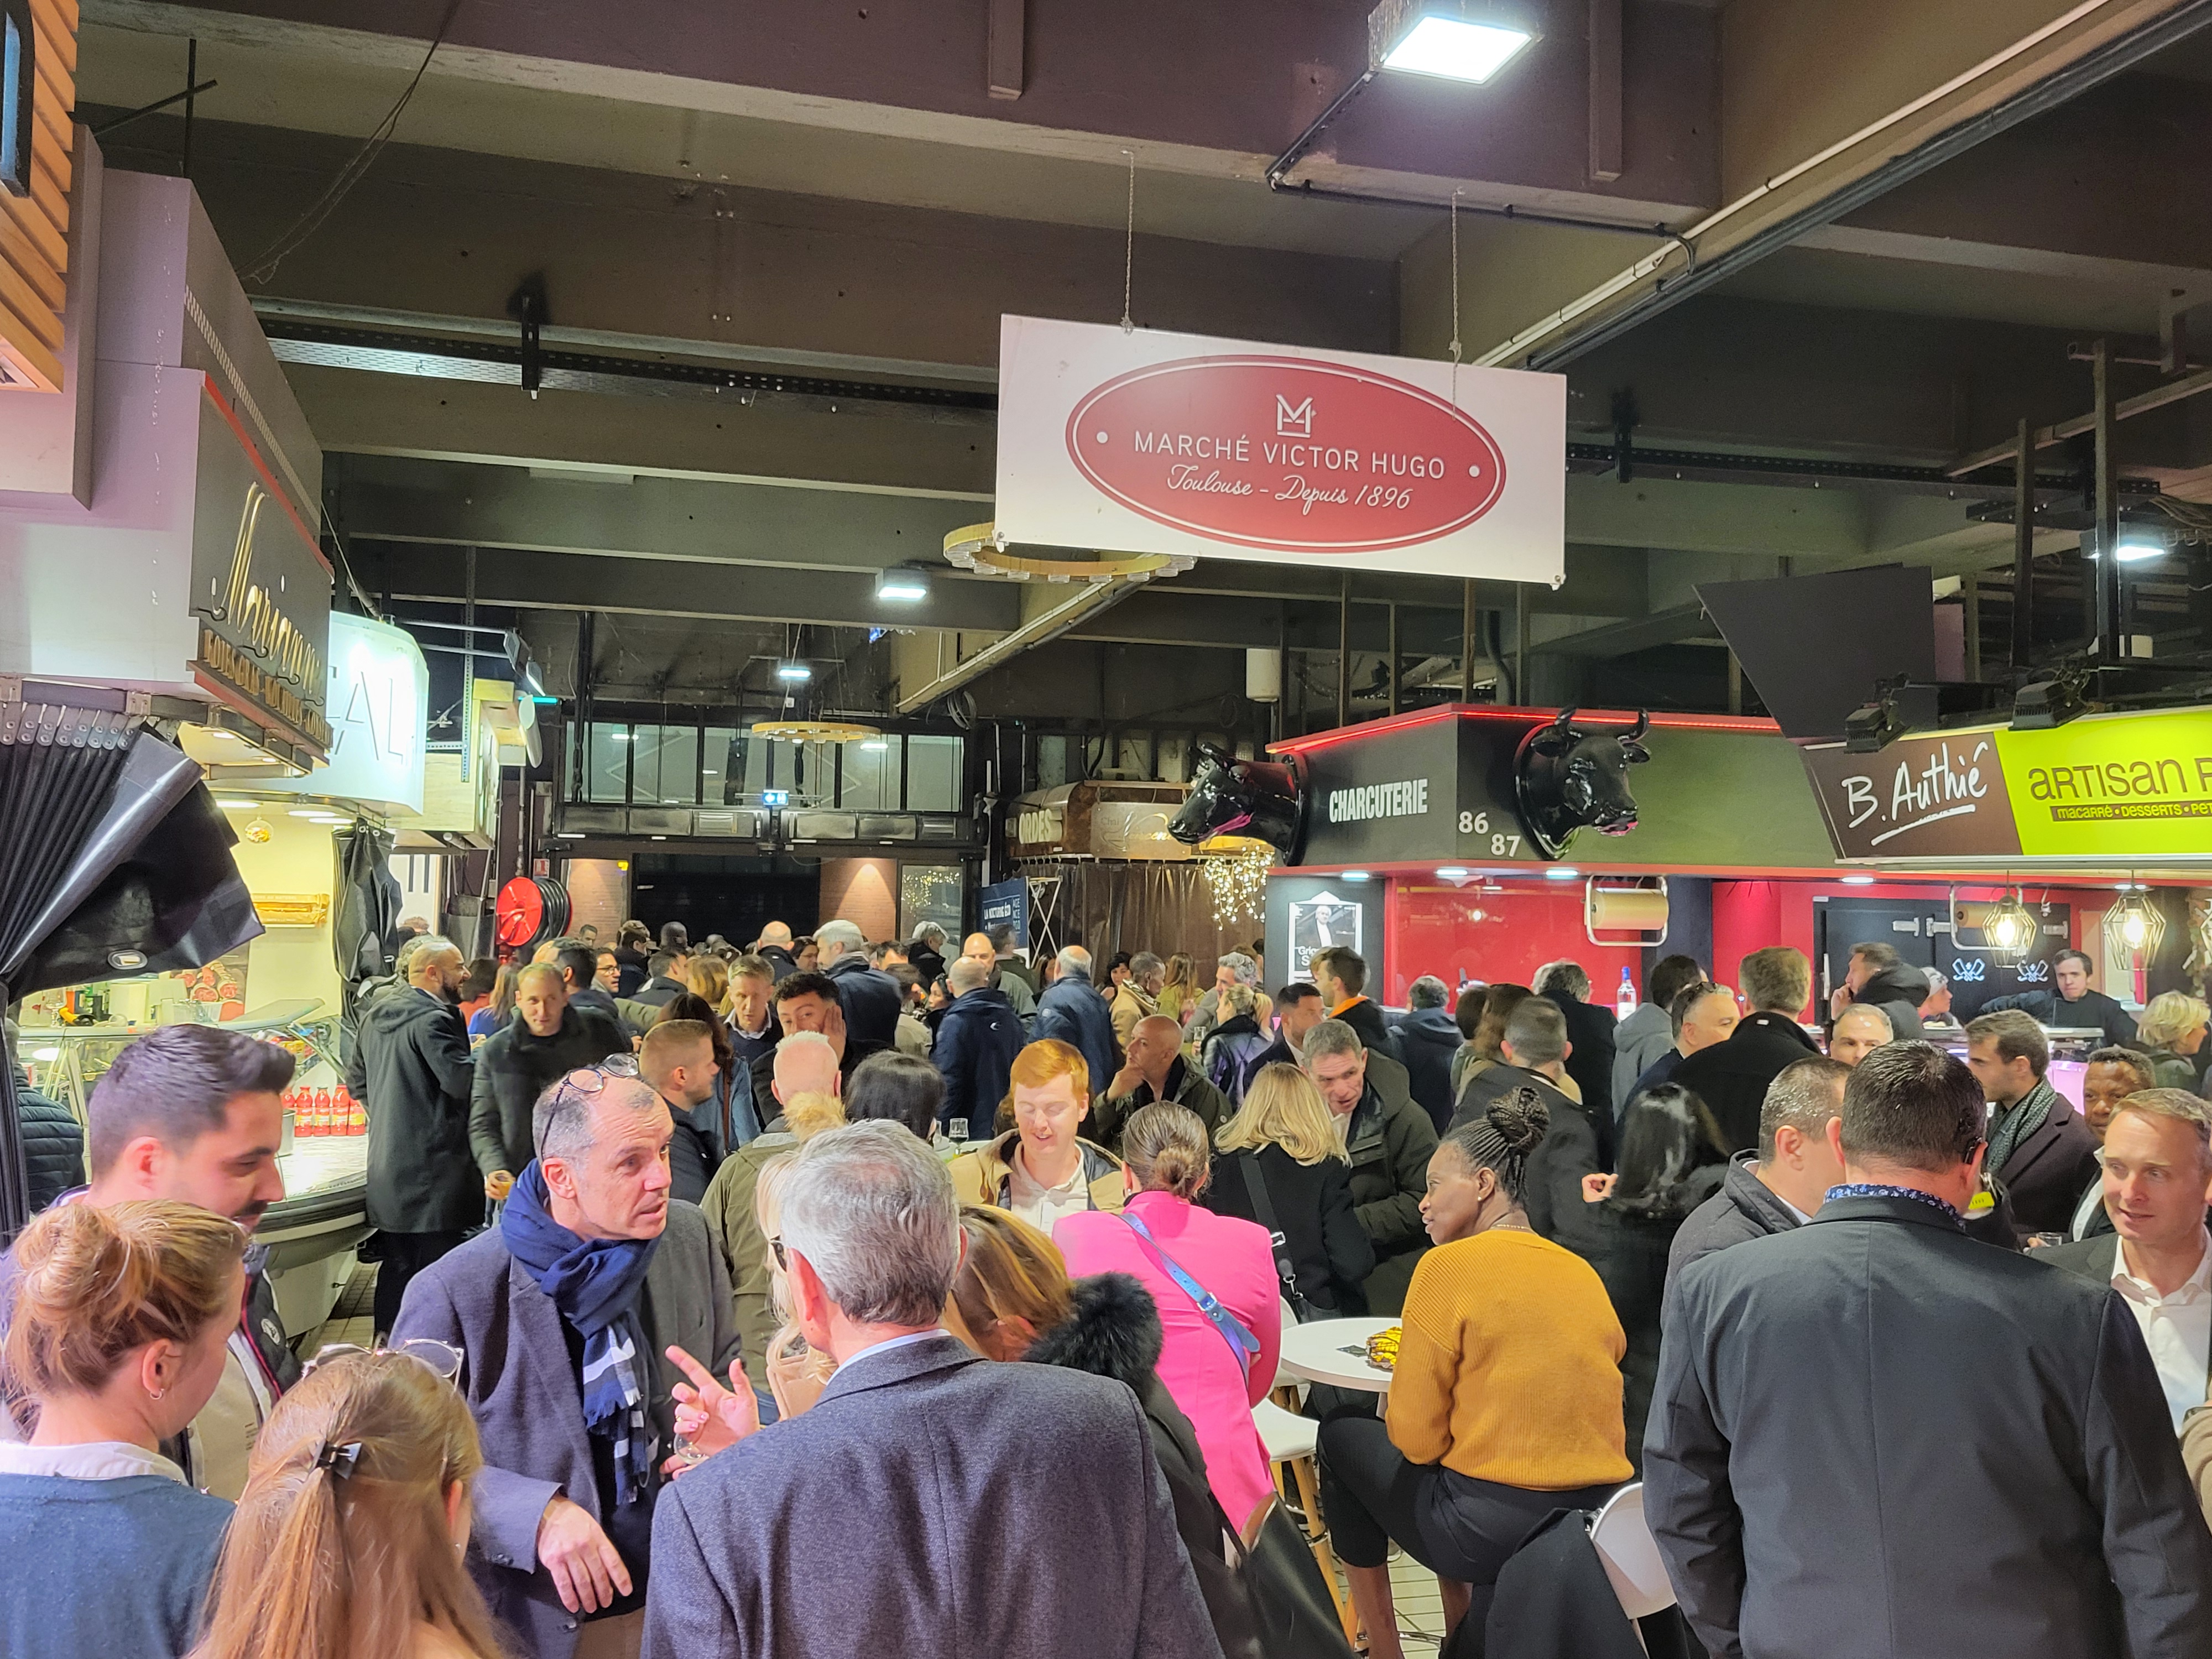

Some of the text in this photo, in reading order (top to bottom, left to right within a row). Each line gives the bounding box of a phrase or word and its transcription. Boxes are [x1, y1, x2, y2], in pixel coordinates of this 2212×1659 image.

[1134, 430, 1446, 481] MARCHÉ VICTOR HUGO
[1166, 463, 1254, 498] Toulouse
[1274, 474, 1348, 516] Depuis
[1353, 485, 1413, 510] 1896
[204, 629, 235, 679] FOIES
[1329, 778, 1428, 823] CHARCUTERIE
[1458, 811, 1489, 834] 86
[1490, 833, 1521, 858] 87
